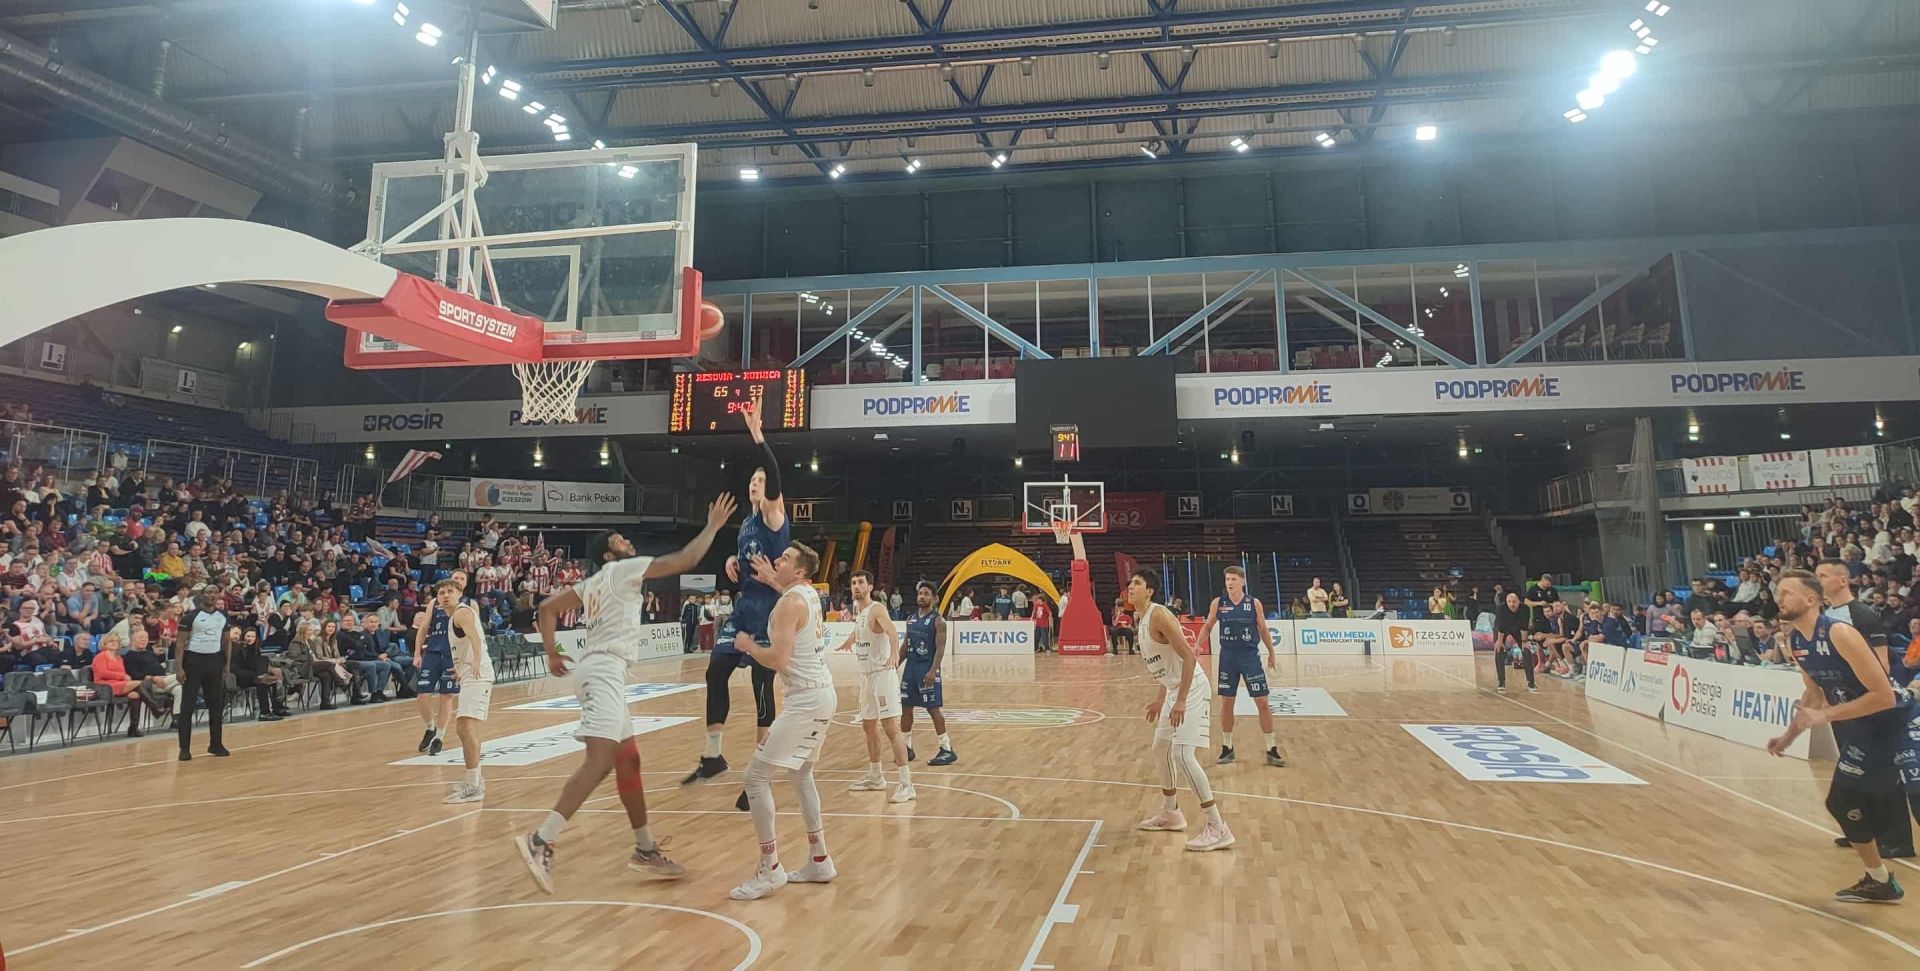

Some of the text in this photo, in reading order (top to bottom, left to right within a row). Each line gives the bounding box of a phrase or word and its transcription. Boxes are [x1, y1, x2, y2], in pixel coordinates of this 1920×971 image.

[713, 386, 729, 398] 65
[749, 384, 764, 396] 53
[569, 493, 621, 503] Bank Pekao
[796, 504, 809, 516] M
[896, 503, 909, 514] M
[651, 627, 680, 640] SOLARE
[1318, 630, 1375, 639] KIWI MEDIA
[1815, 640, 1831, 656] 44
[1250, 682, 1260, 692] 10
[1692, 677, 1722, 701] Energia
[1690, 697, 1717, 717] Polska
